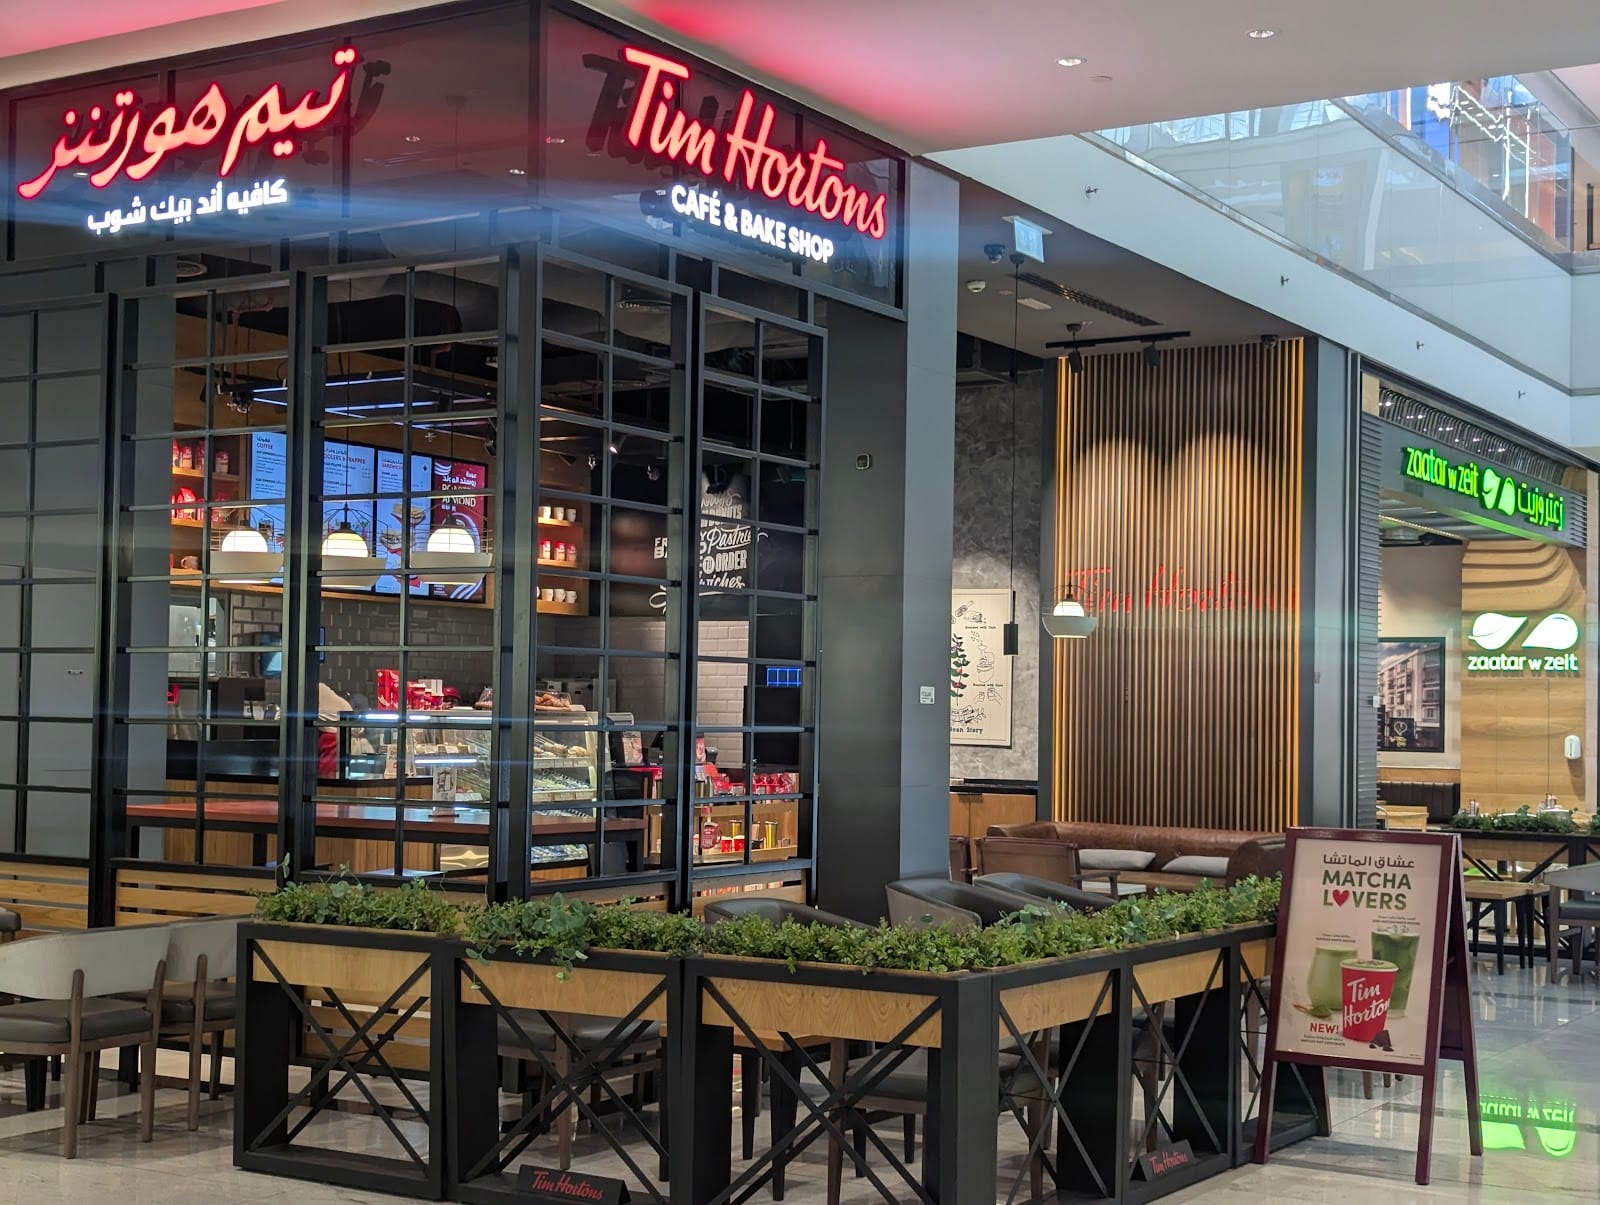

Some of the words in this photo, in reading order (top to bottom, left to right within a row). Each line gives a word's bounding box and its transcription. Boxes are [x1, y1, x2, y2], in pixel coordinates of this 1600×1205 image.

[221, 47, 358, 176] تيم
[17, 81, 228, 200] هورتنز
[623, 46, 716, 176] Tim
[724, 88, 887, 240] Hortons
[150, 195, 193, 225] بيك
[196, 182, 224, 215] أند
[227, 178, 289, 217] كافيه
[87, 196, 147, 235] شوب
[670, 184, 722, 228] CAFÉ
[724, 203, 739, 233] &
[740, 210, 788, 251] BAKE
[788, 226, 835, 264] SHOP
[1406, 447, 1448, 487] zaatar
[1448, 472, 1458, 490] w
[1457, 463, 1480, 499] zeit
[715, 550, 748, 572] ORDER
[1467, 653, 1526, 671] zaatar
[1528, 658, 1542, 671] w
[1543, 653, 1579, 671] zeit
[1323, 851, 1372, 867] الماتشا
[1374, 853, 1415, 870] عشاق
[1322, 870, 1412, 890] MATCHA
[1347, 977, 1381, 1003] Tim
[1310, 1022, 1339, 1035] NEW!
[532, 1170, 554, 1190] Tim
[555, 1174, 603, 1201] Hortons
